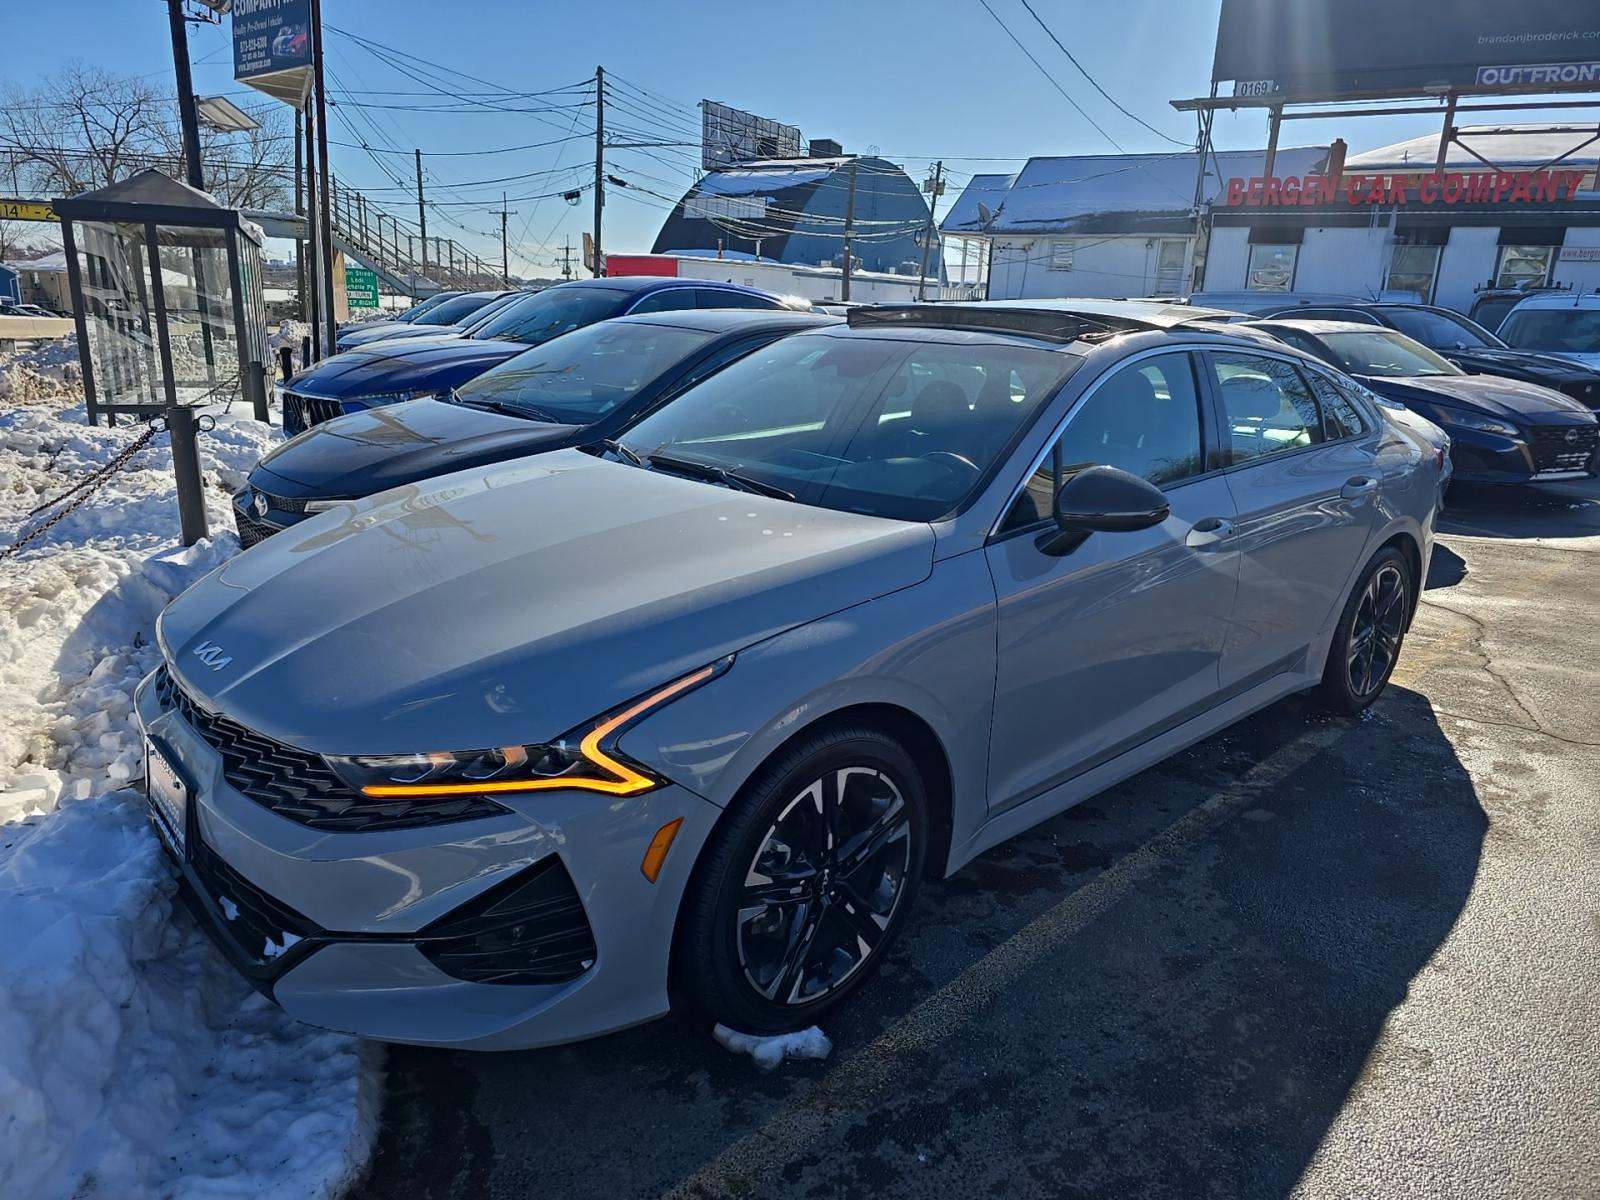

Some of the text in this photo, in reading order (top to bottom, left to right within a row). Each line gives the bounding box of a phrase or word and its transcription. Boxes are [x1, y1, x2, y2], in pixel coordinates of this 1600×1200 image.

[1241, 82, 1267, 96] 0169
[1227, 170, 1587, 207] BERGEN CAR COMPANY
